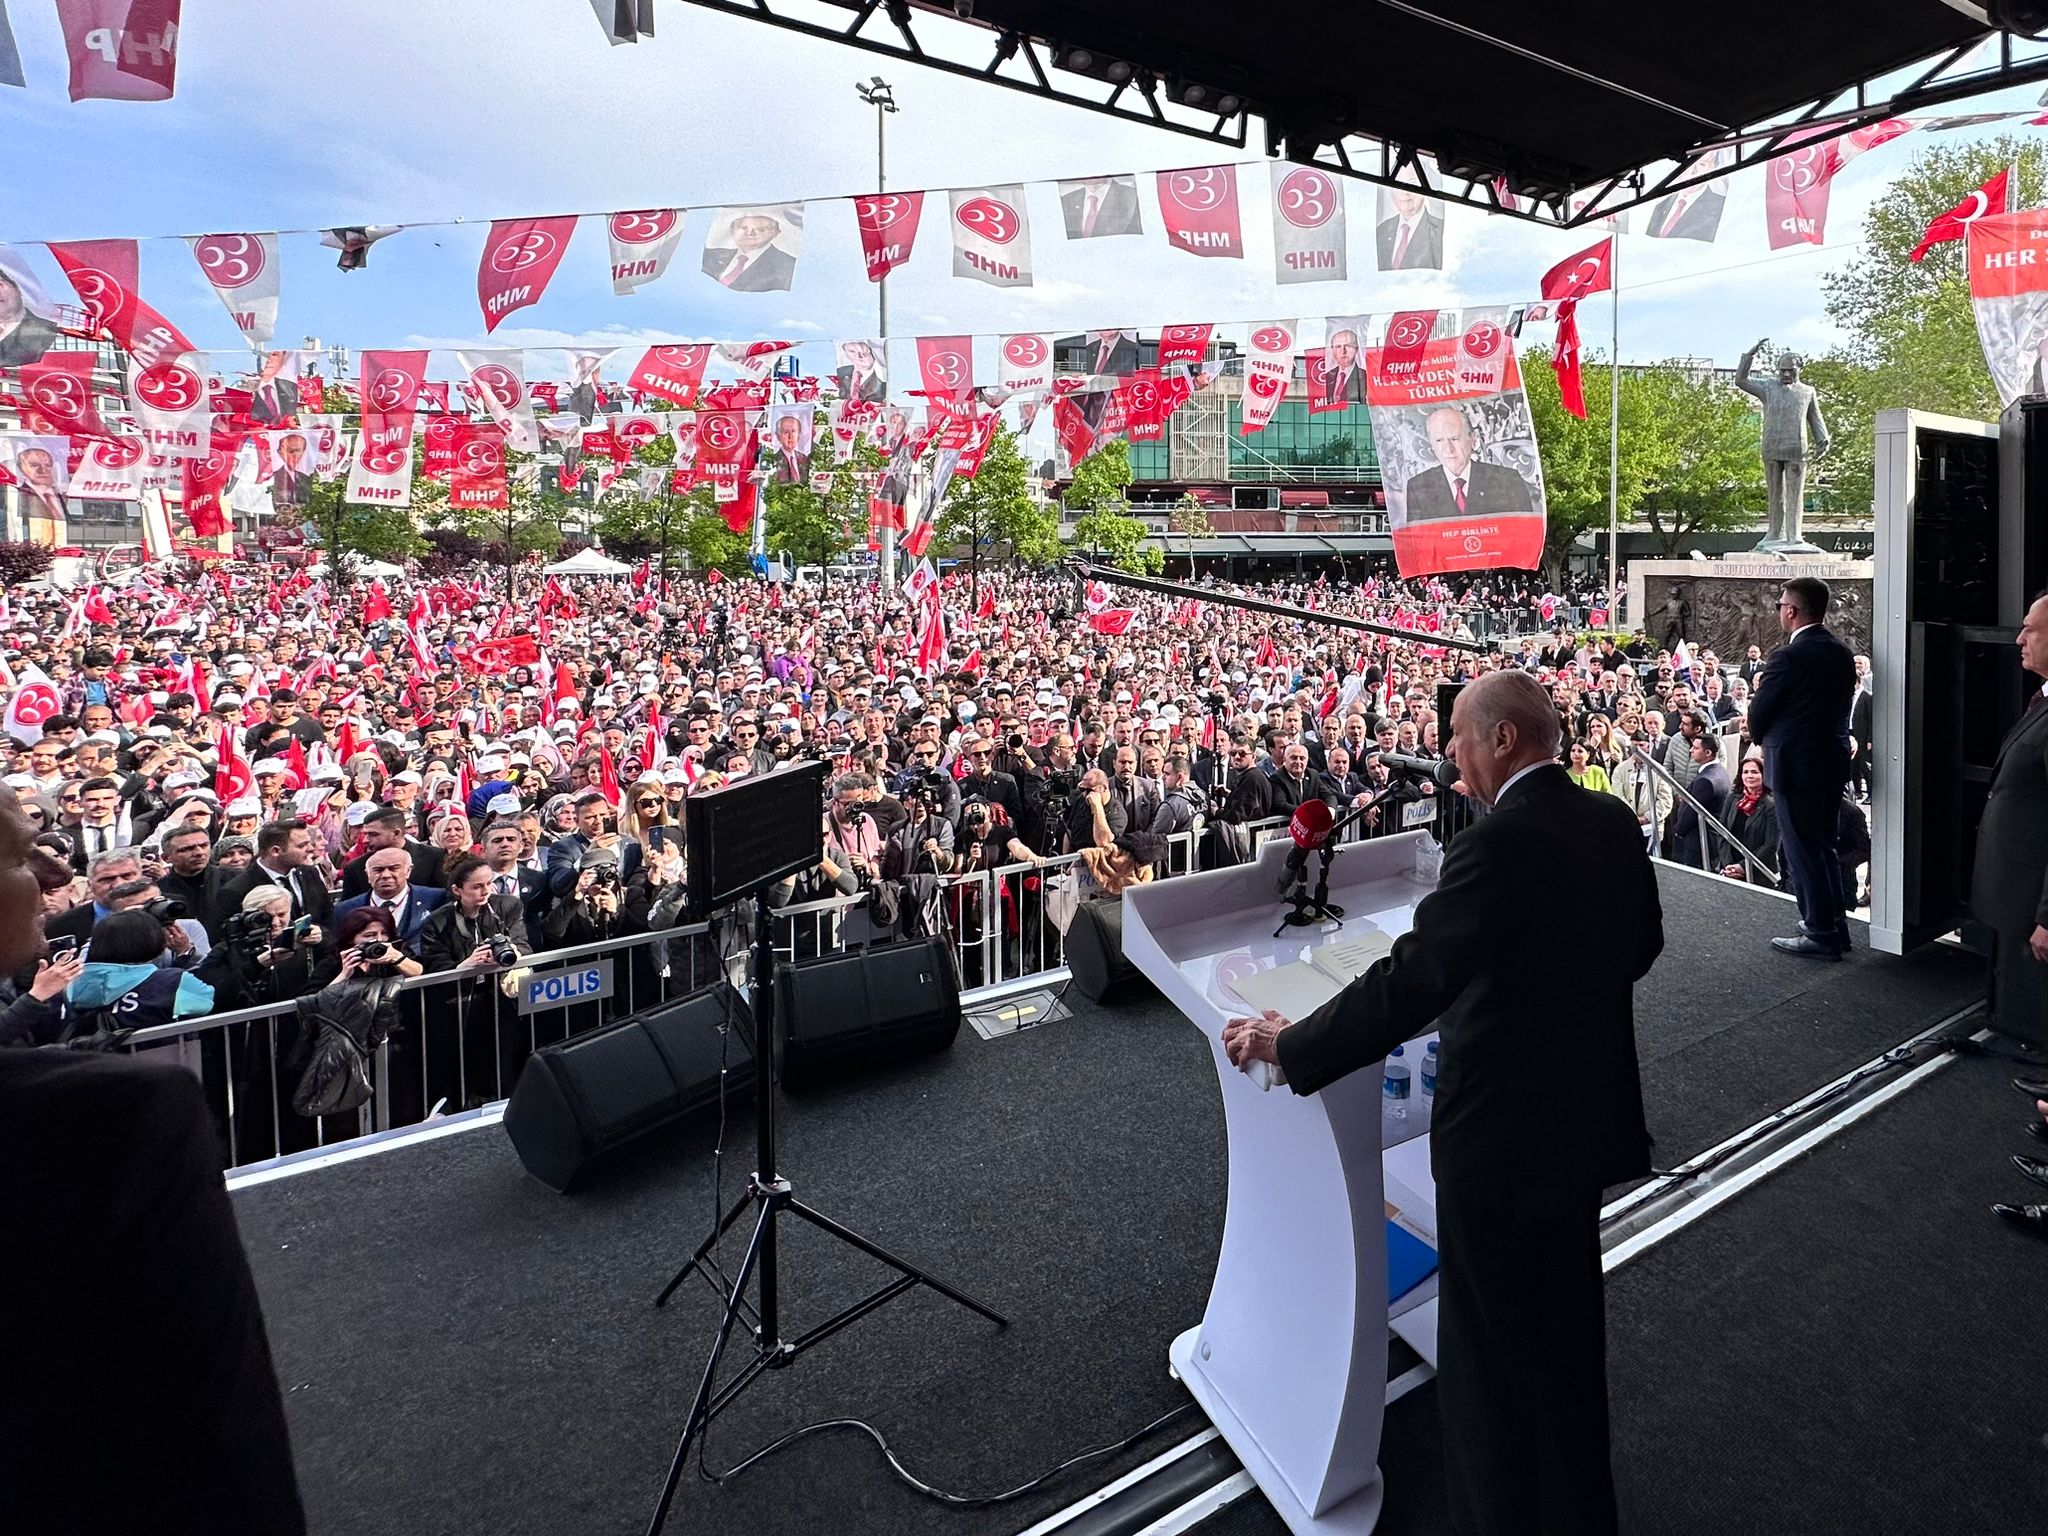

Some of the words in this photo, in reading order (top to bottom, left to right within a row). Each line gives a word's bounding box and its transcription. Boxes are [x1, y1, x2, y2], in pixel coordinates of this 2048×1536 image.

[1984, 248, 2037, 270] HER
[1133, 423, 1160, 436] MHP
[705, 463, 741, 475] MHP
[82, 480, 132, 493] MHP
[357, 486, 402, 500] MHP
[460, 489, 500, 502] MHP
[1834, 536, 1873, 551] house
[529, 968, 601, 1005] POLIS
